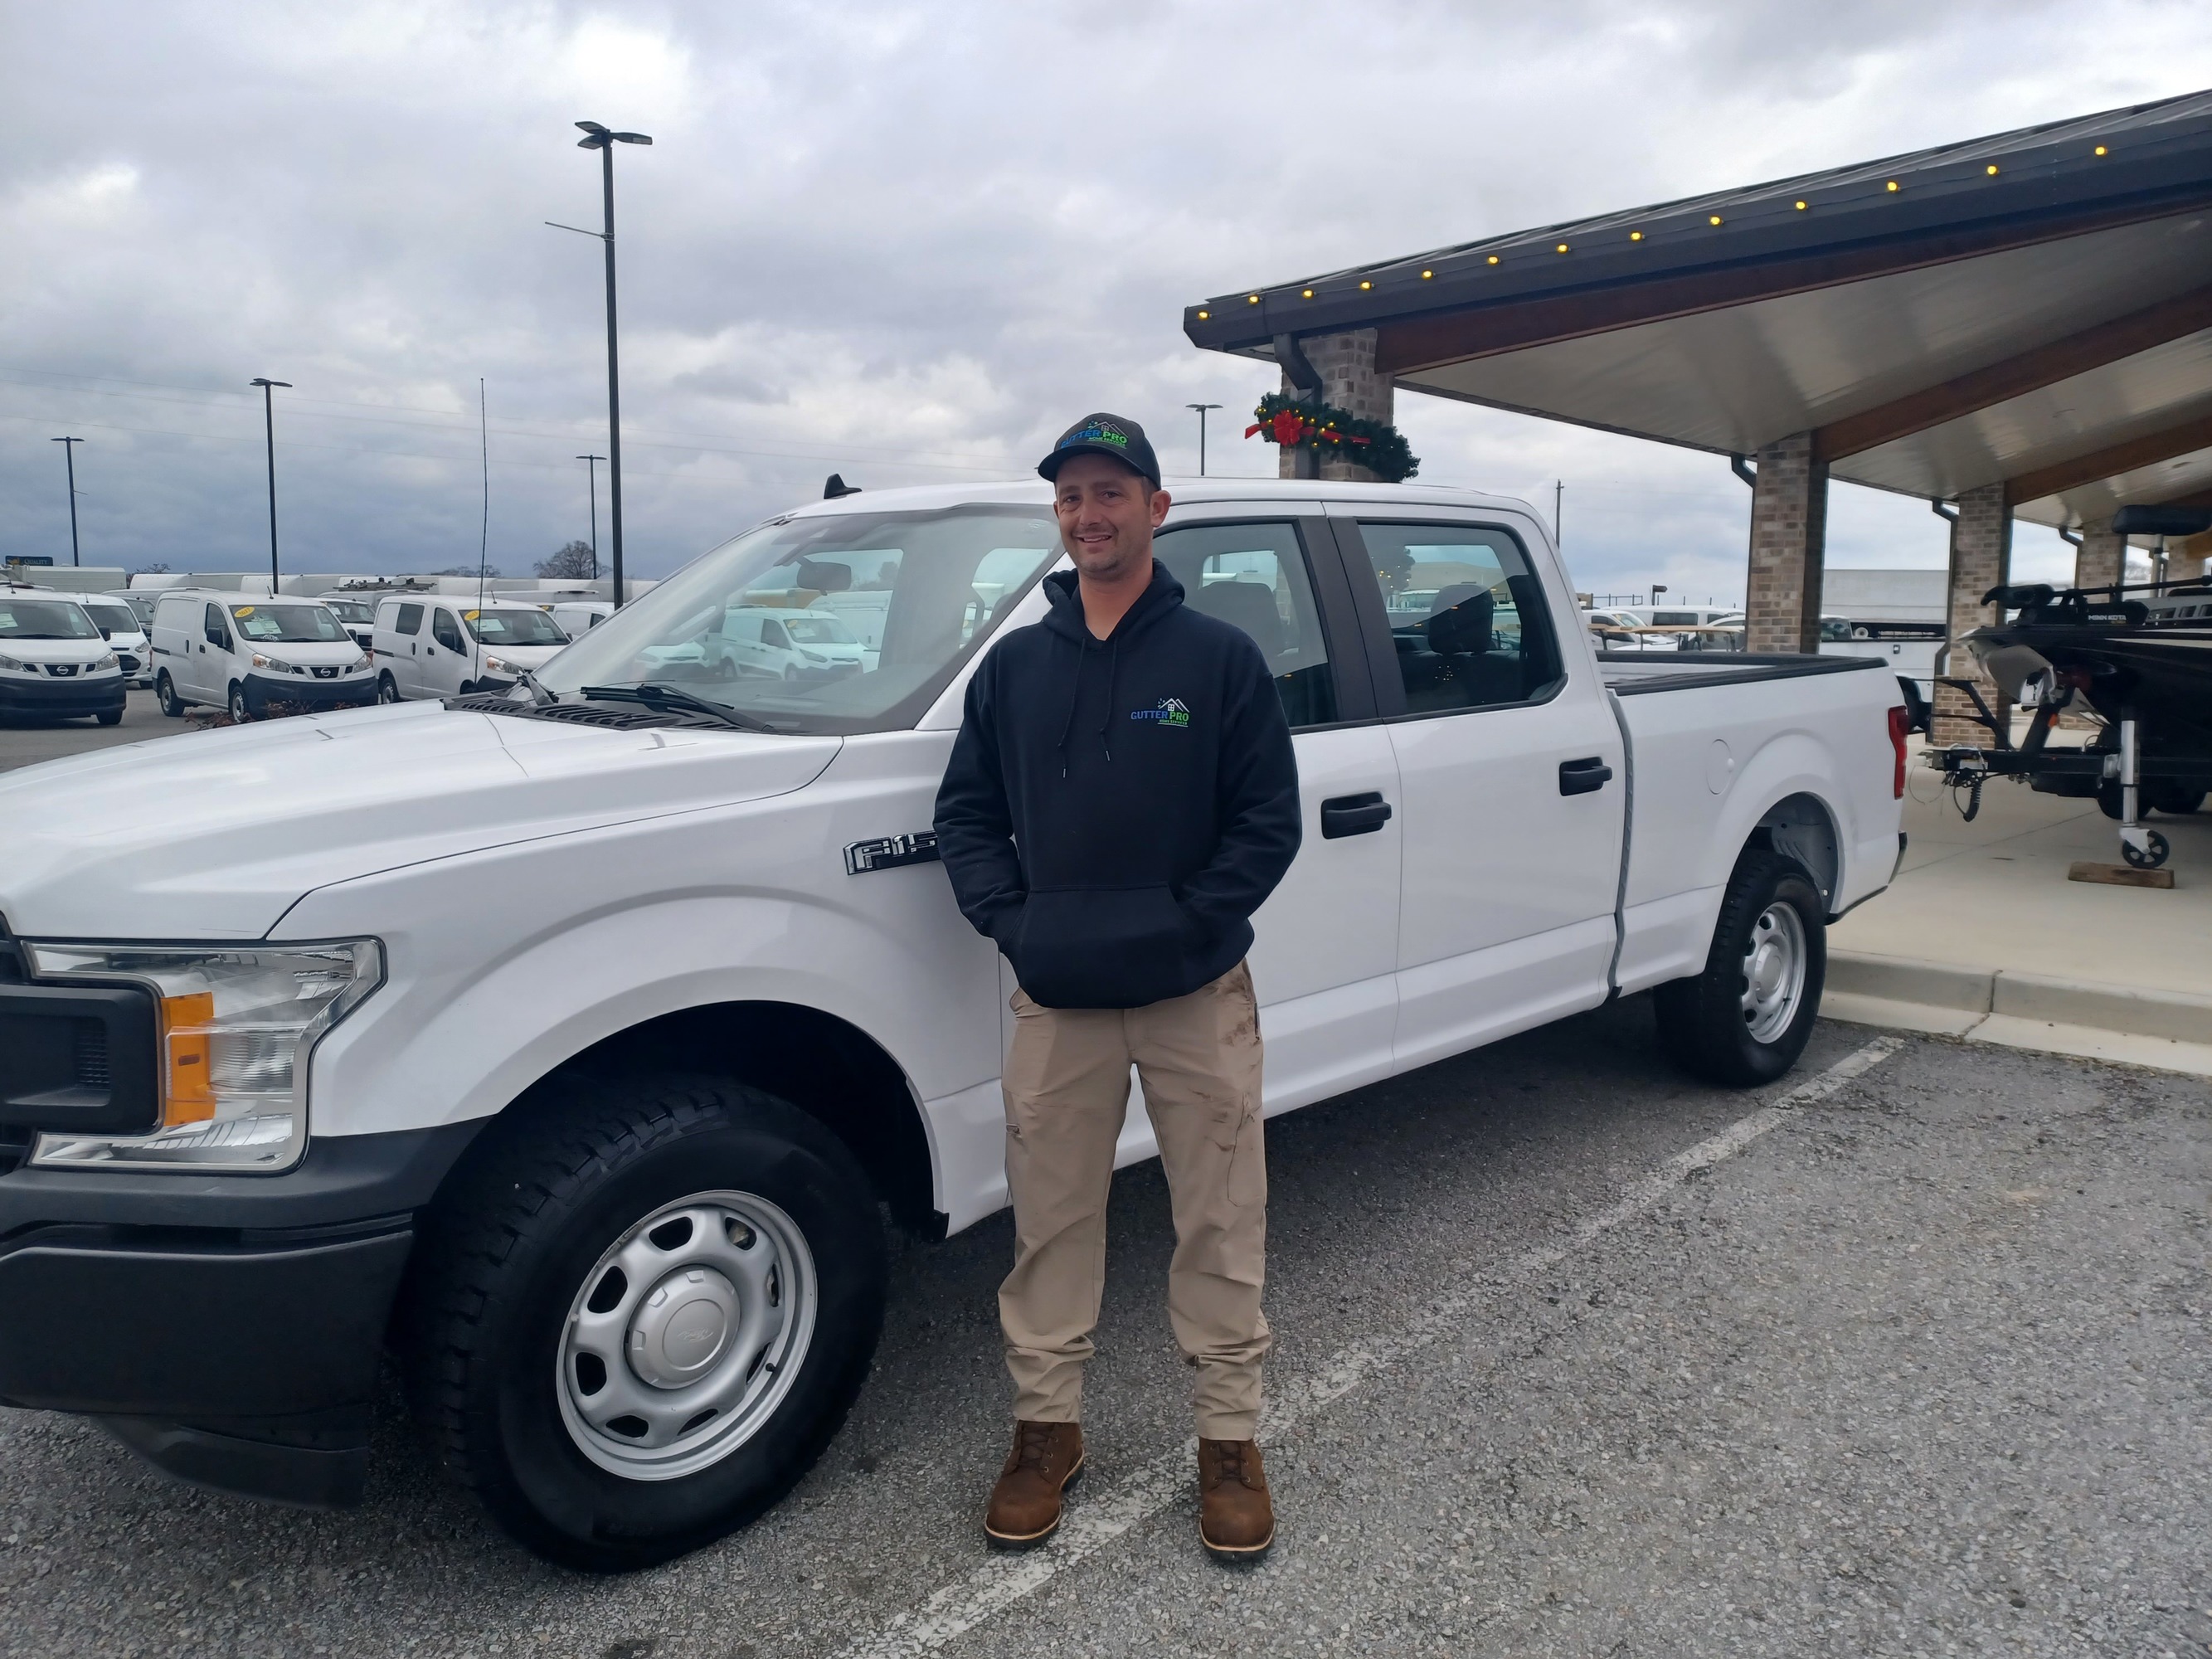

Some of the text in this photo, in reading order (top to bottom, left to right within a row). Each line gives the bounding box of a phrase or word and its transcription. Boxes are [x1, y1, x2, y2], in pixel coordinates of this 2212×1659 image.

[1061, 429, 1128, 449] GUTTER PRO
[1130, 710, 1189, 722] GUTTER PRO
